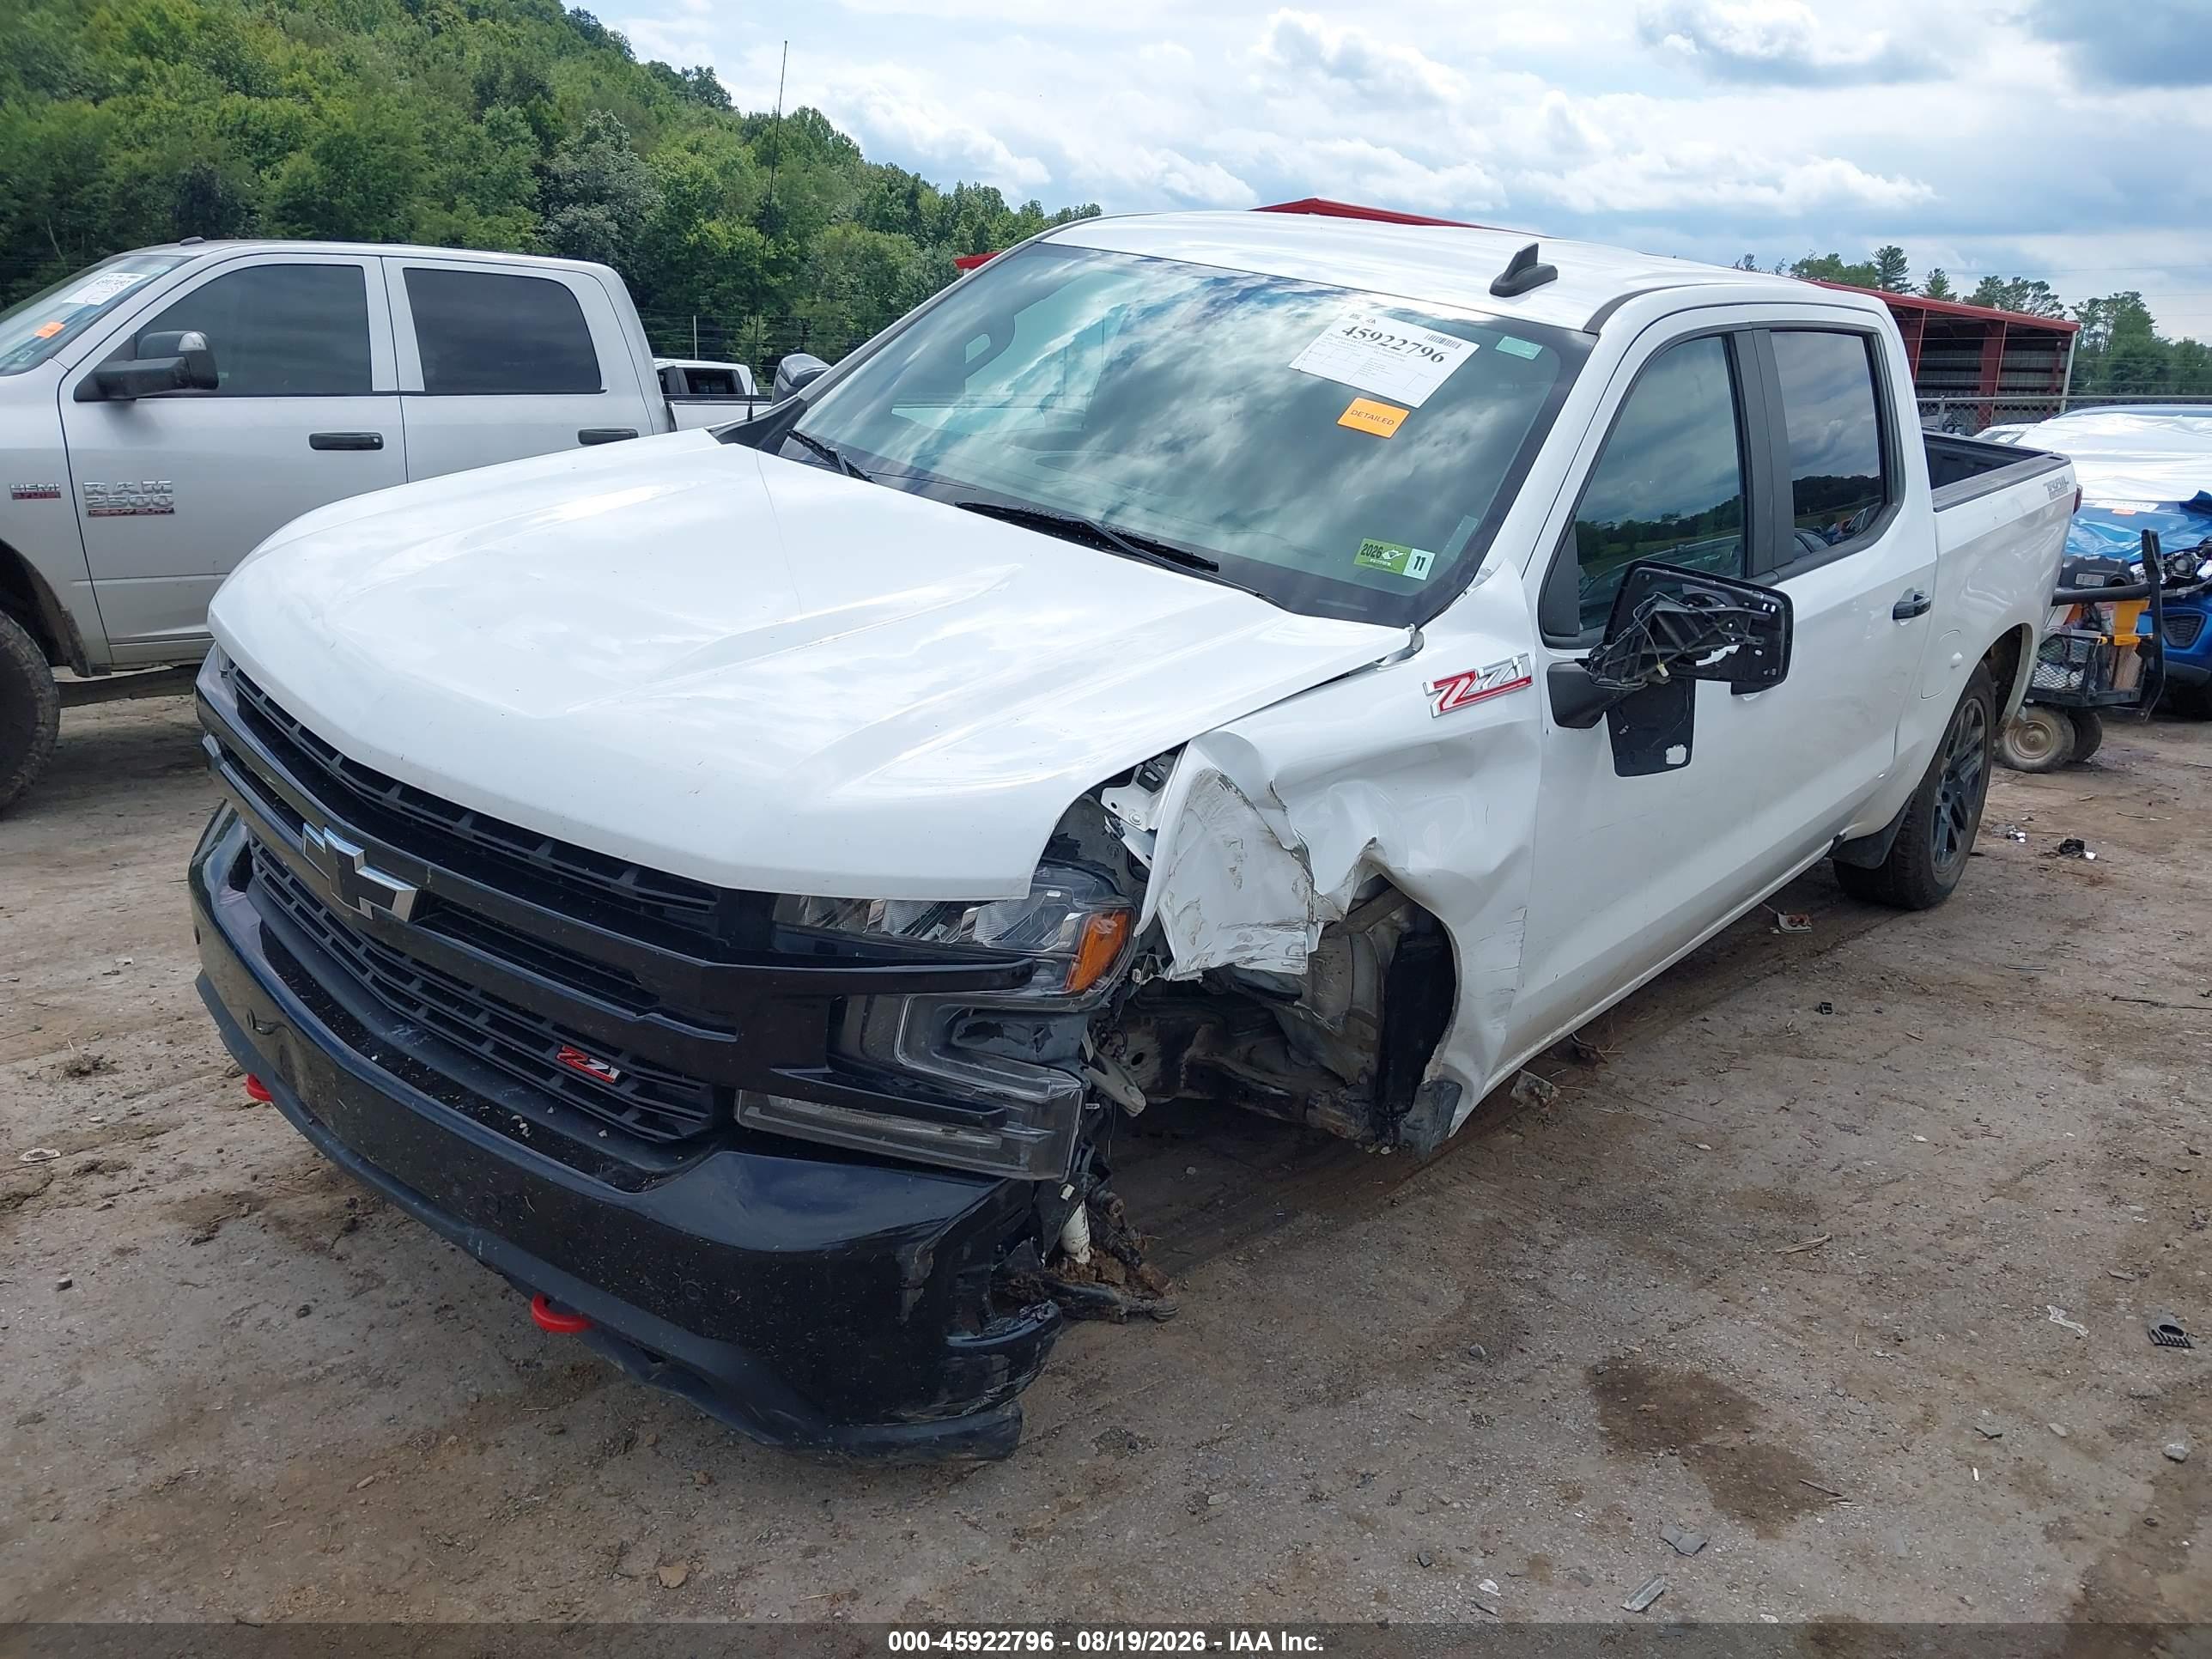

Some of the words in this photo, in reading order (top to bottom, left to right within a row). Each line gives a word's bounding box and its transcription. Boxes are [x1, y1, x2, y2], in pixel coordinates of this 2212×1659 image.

[1341, 325, 1449, 363] 45922796
[1350, 409, 1395, 427] DETAILED
[9, 483, 60, 492] HEMI
[82, 480, 173, 495] RAM
[84, 493, 174, 508] 2500
[1360, 543, 1383, 559] 2026
[1413, 555, 1427, 572] 11
[1422, 652, 1534, 719] Z71
[556, 1045, 620, 1084] Z71
